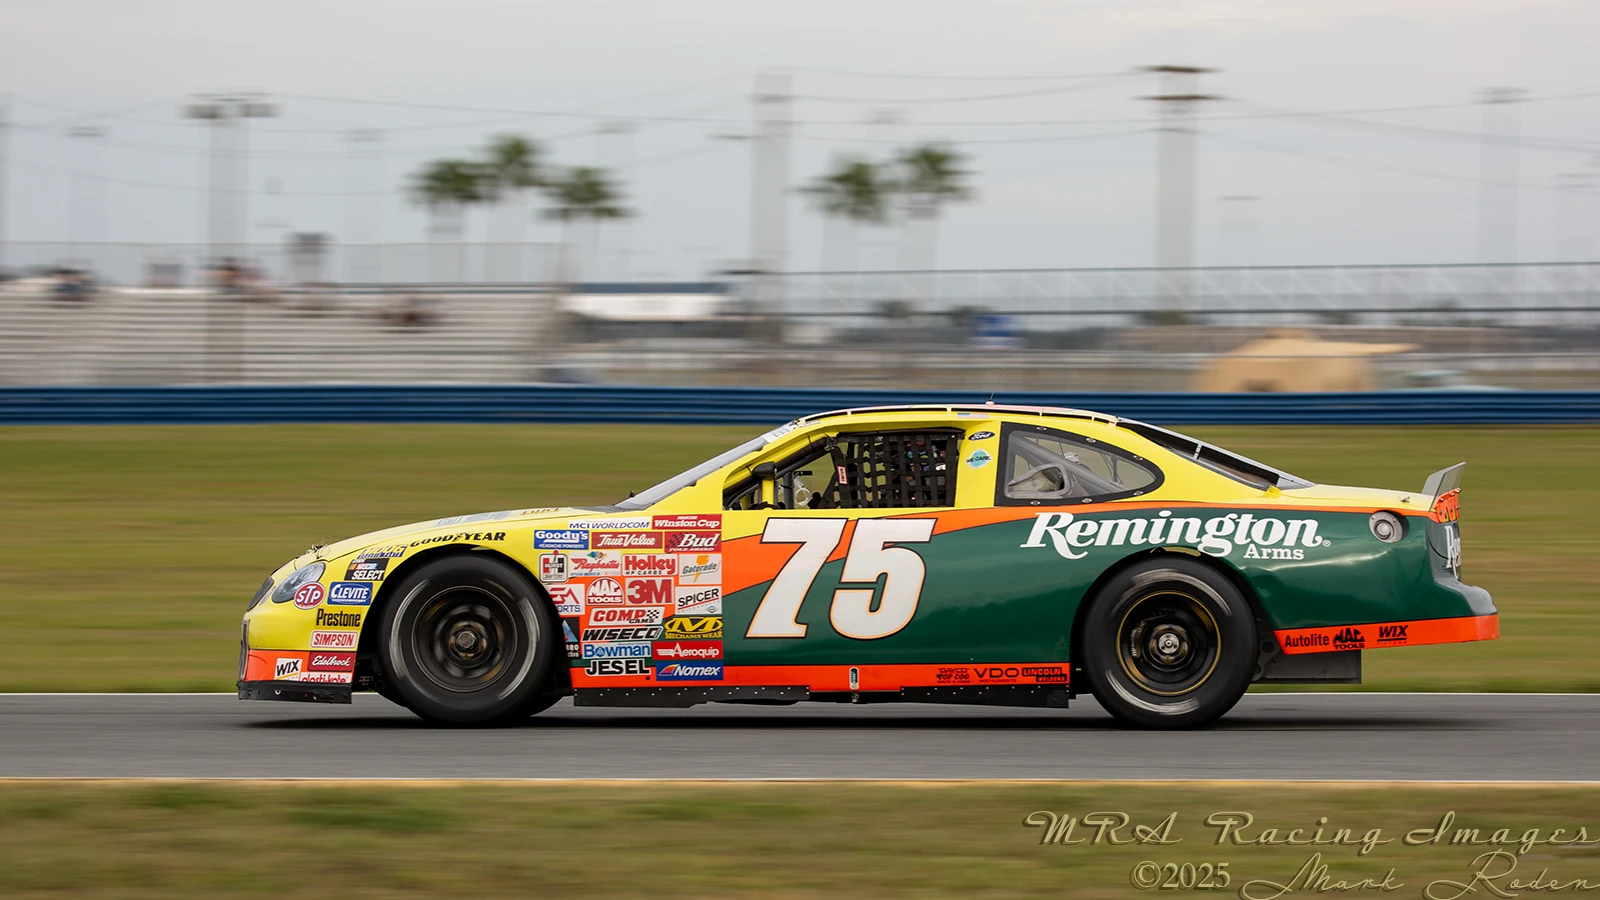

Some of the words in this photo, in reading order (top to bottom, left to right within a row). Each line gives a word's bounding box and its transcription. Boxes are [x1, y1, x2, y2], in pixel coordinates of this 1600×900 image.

[654, 519, 697, 527] Winston
[697, 519, 720, 528] Cup
[535, 530, 588, 542] Goody's
[677, 533, 721, 548] Bud
[1020, 510, 1324, 560] Remington
[1243, 545, 1305, 560] Arms
[624, 554, 676, 575] Holley
[682, 562, 718, 575] Gatorade
[351, 570, 385, 580] SELECT
[743, 517, 938, 640] 75
[330, 584, 369, 599] CLEVITE
[589, 578, 622, 597] MAC
[627, 579, 673, 605] 3M
[296, 585, 321, 605] STP
[677, 588, 719, 607] SPICER
[556, 604, 581, 613] ORTS
[593, 609, 647, 622] COMP
[316, 608, 361, 628] Prestone
[582, 627, 663, 641] WISECO
[1333, 627, 1365, 644] MAC
[1379, 625, 1409, 638] WIX
[314, 633, 355, 647] SIMPSON
[1285, 633, 1330, 647] Autolite
[584, 643, 651, 657] Bowman
[671, 642, 720, 658] Aeroquip
[312, 655, 351, 666] Edelbrock
[276, 660, 300, 676] WIX
[586, 660, 650, 676] JESEL
[673, 665, 721, 676] Nomex
[973, 667, 1020, 679] VDO
[1023, 668, 1061, 676] LINCOLN
